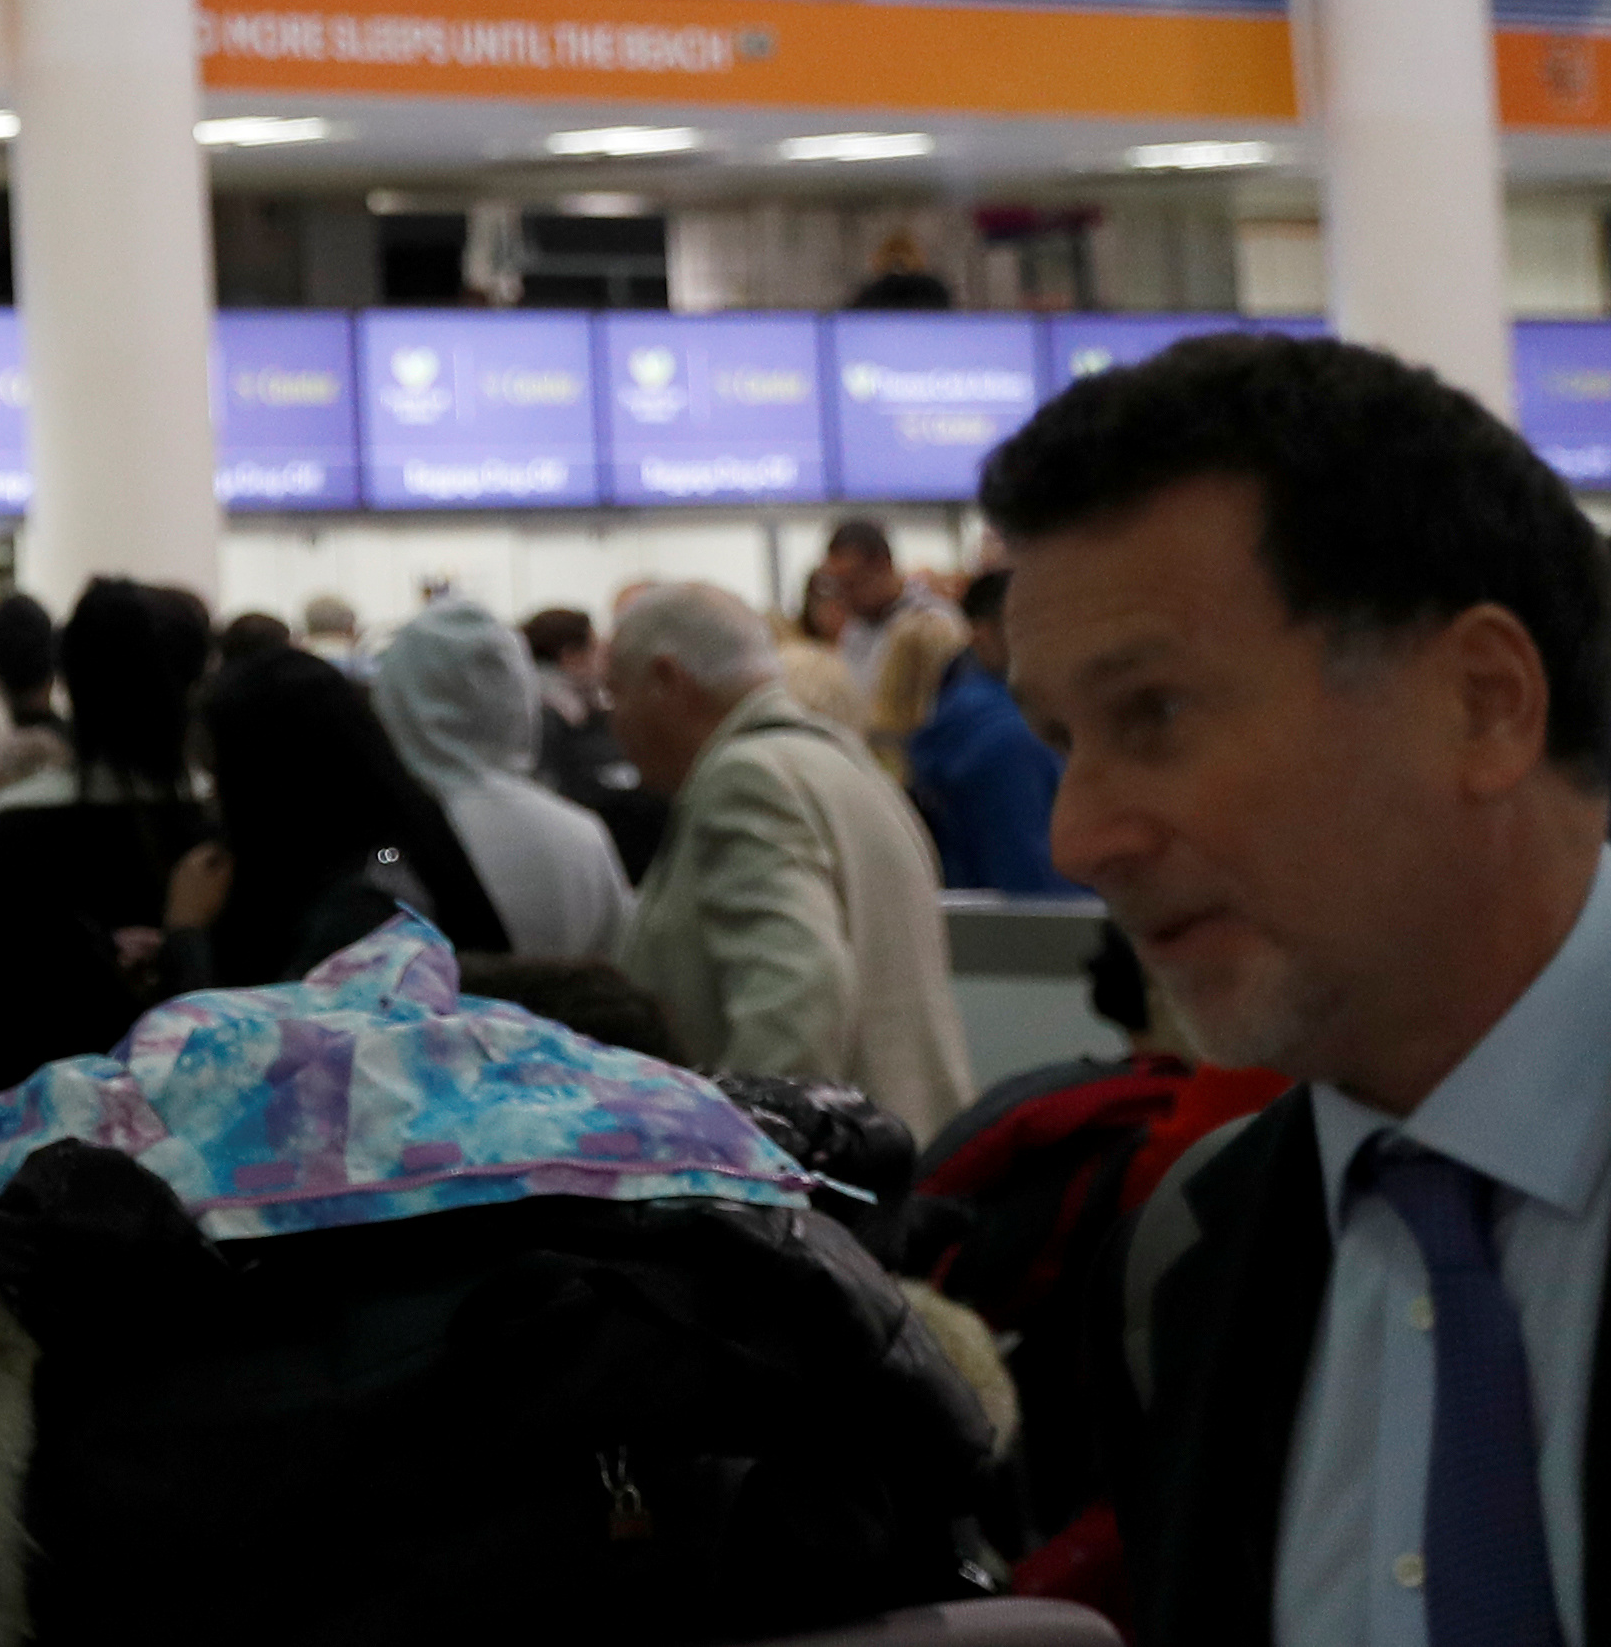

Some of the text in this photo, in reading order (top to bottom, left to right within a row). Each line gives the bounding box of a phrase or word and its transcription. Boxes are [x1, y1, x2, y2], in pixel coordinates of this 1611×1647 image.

[223, 13, 325, 61] MORE
[328, 14, 445, 65] SLEEPS
[452, 19, 551, 67] UNTIL
[552, 23, 614, 70] THE
[616, 24, 731, 74] BEACH
